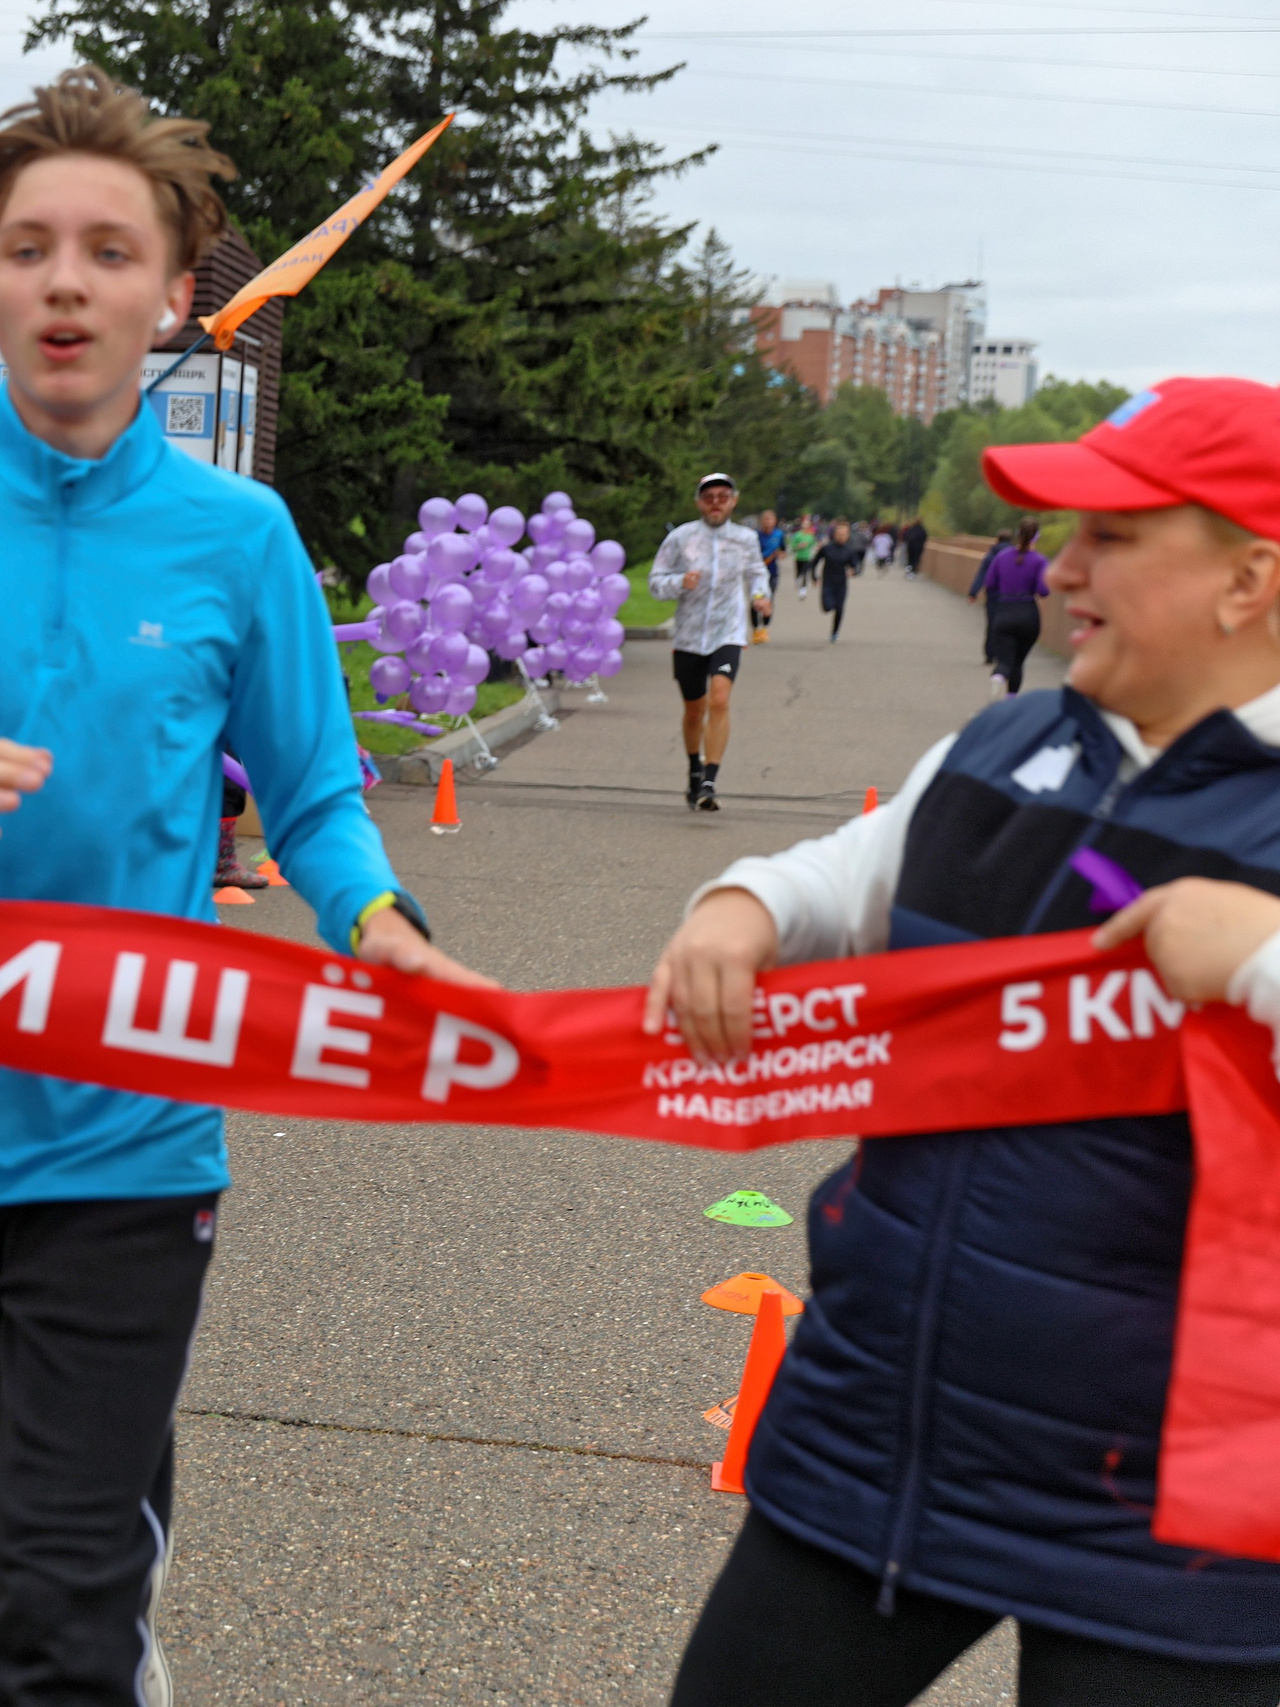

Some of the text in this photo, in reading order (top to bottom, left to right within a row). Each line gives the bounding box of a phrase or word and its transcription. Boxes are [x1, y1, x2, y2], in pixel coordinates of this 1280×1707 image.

[998, 980, 1048, 1053] 5
[642, 1032, 892, 1089] КРАСНОЯРСК
[657, 1078, 873, 1126] НАБЕРЕЖНАЯ
